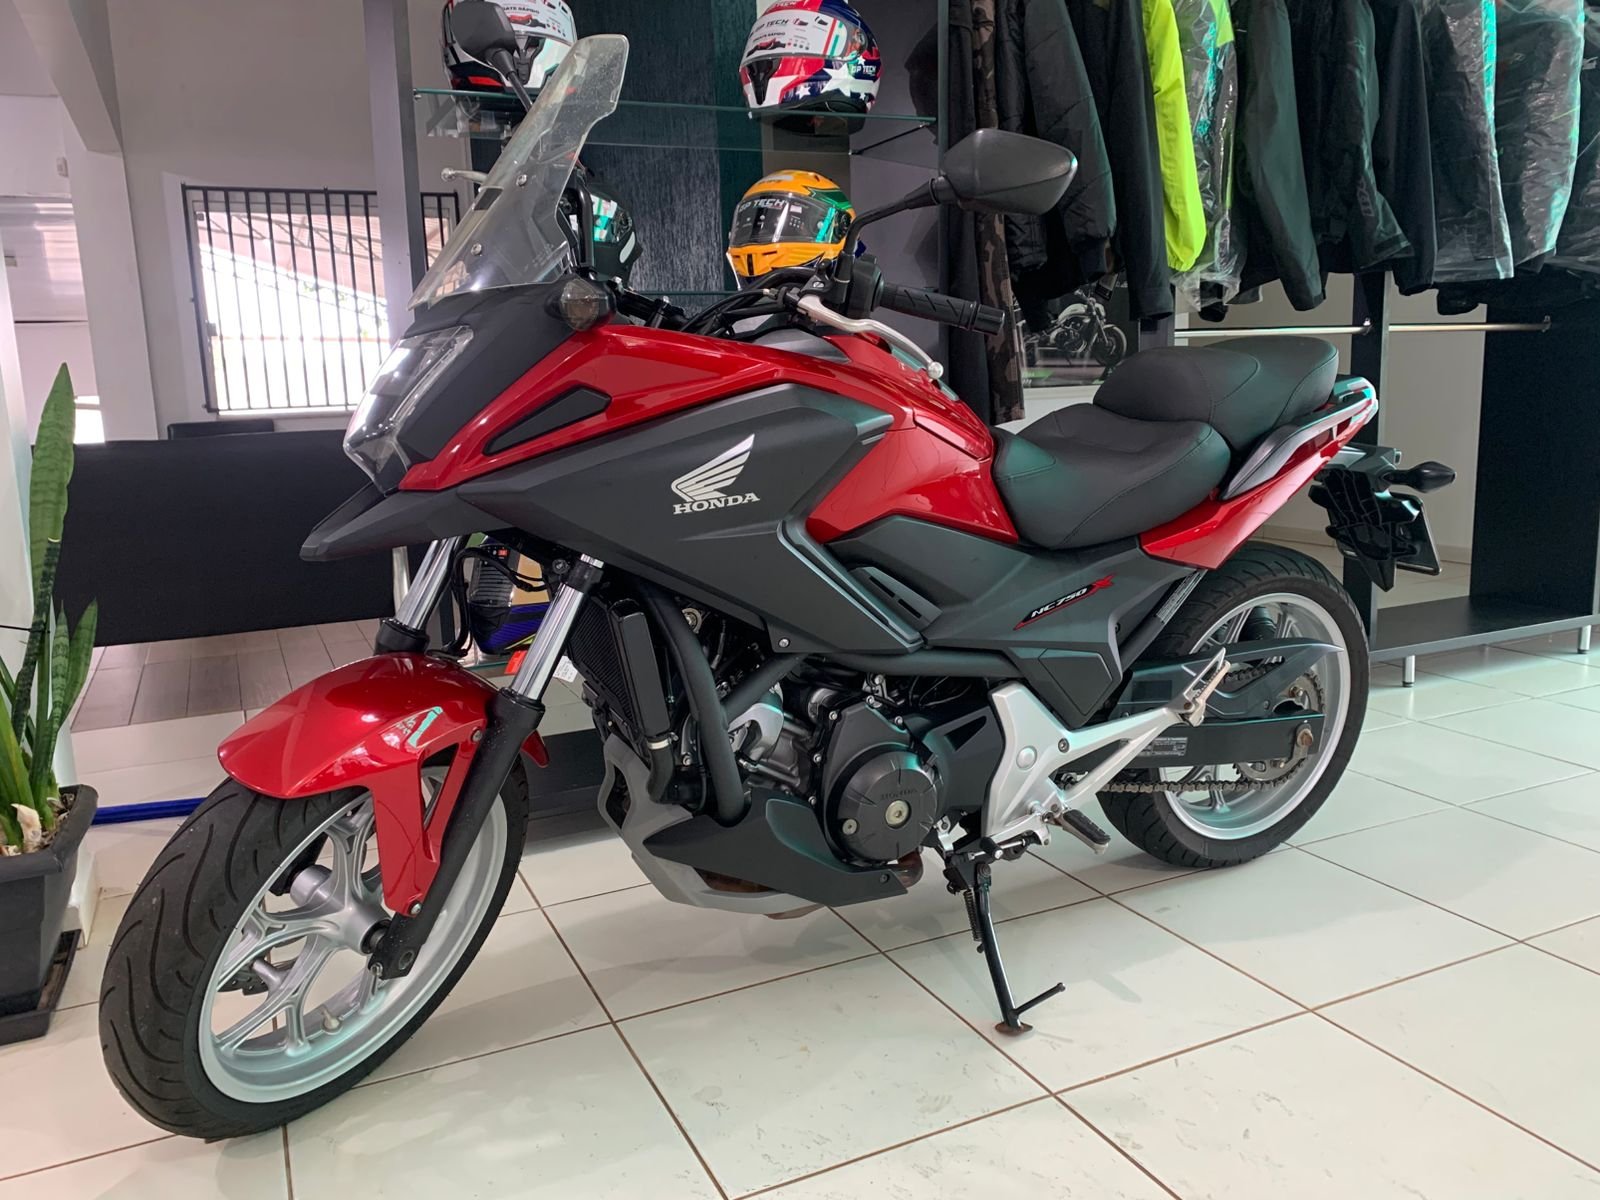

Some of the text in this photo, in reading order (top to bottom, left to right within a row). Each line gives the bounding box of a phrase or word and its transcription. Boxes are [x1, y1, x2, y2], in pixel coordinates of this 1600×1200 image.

[766, 19, 789, 27] TECH
[753, 198, 785, 208] TECH
[673, 492, 760, 515] HONDA
